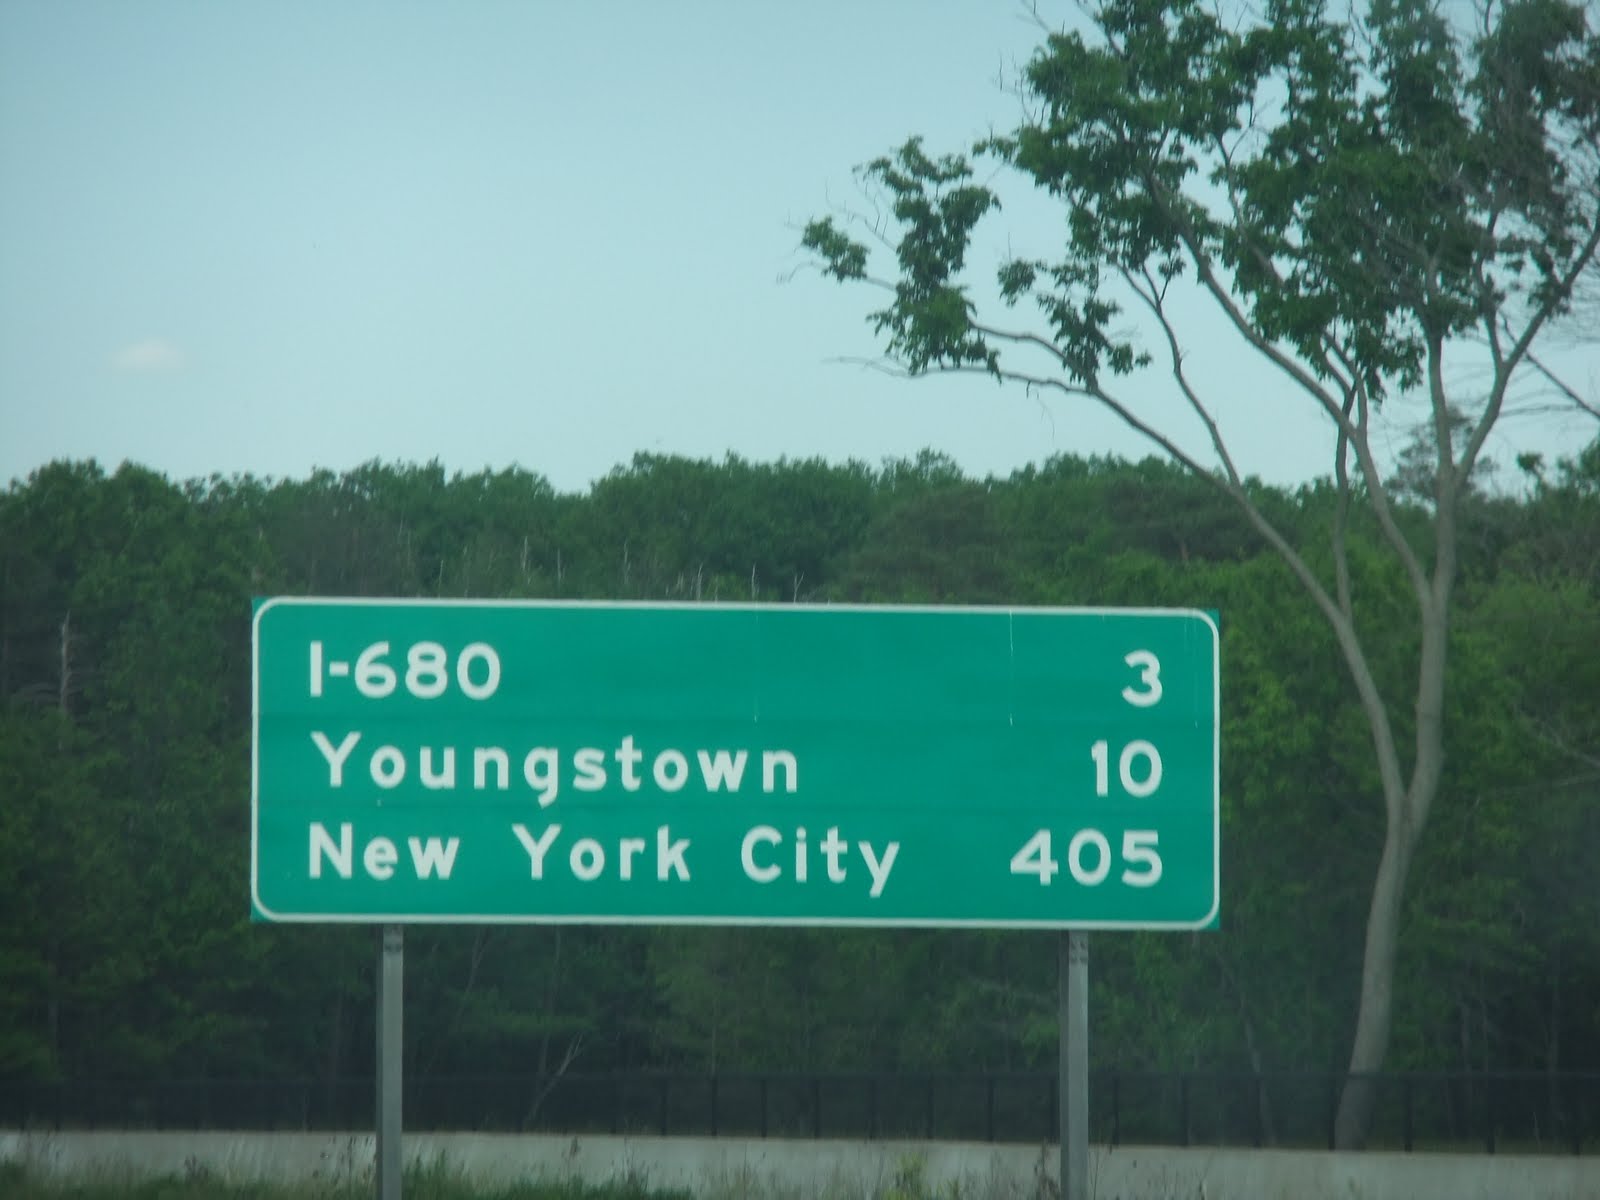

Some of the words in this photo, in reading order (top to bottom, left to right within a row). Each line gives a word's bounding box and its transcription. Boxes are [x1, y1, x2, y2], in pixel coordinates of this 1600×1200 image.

[310, 641, 501, 699] I-680
[1122, 650, 1163, 706] 3
[311, 731, 797, 806] Youngstown
[1091, 740, 1163, 796] 10
[309, 823, 460, 879] New
[513, 824, 690, 881] York
[741, 826, 899, 896] City
[1010, 829, 1163, 886] 405
